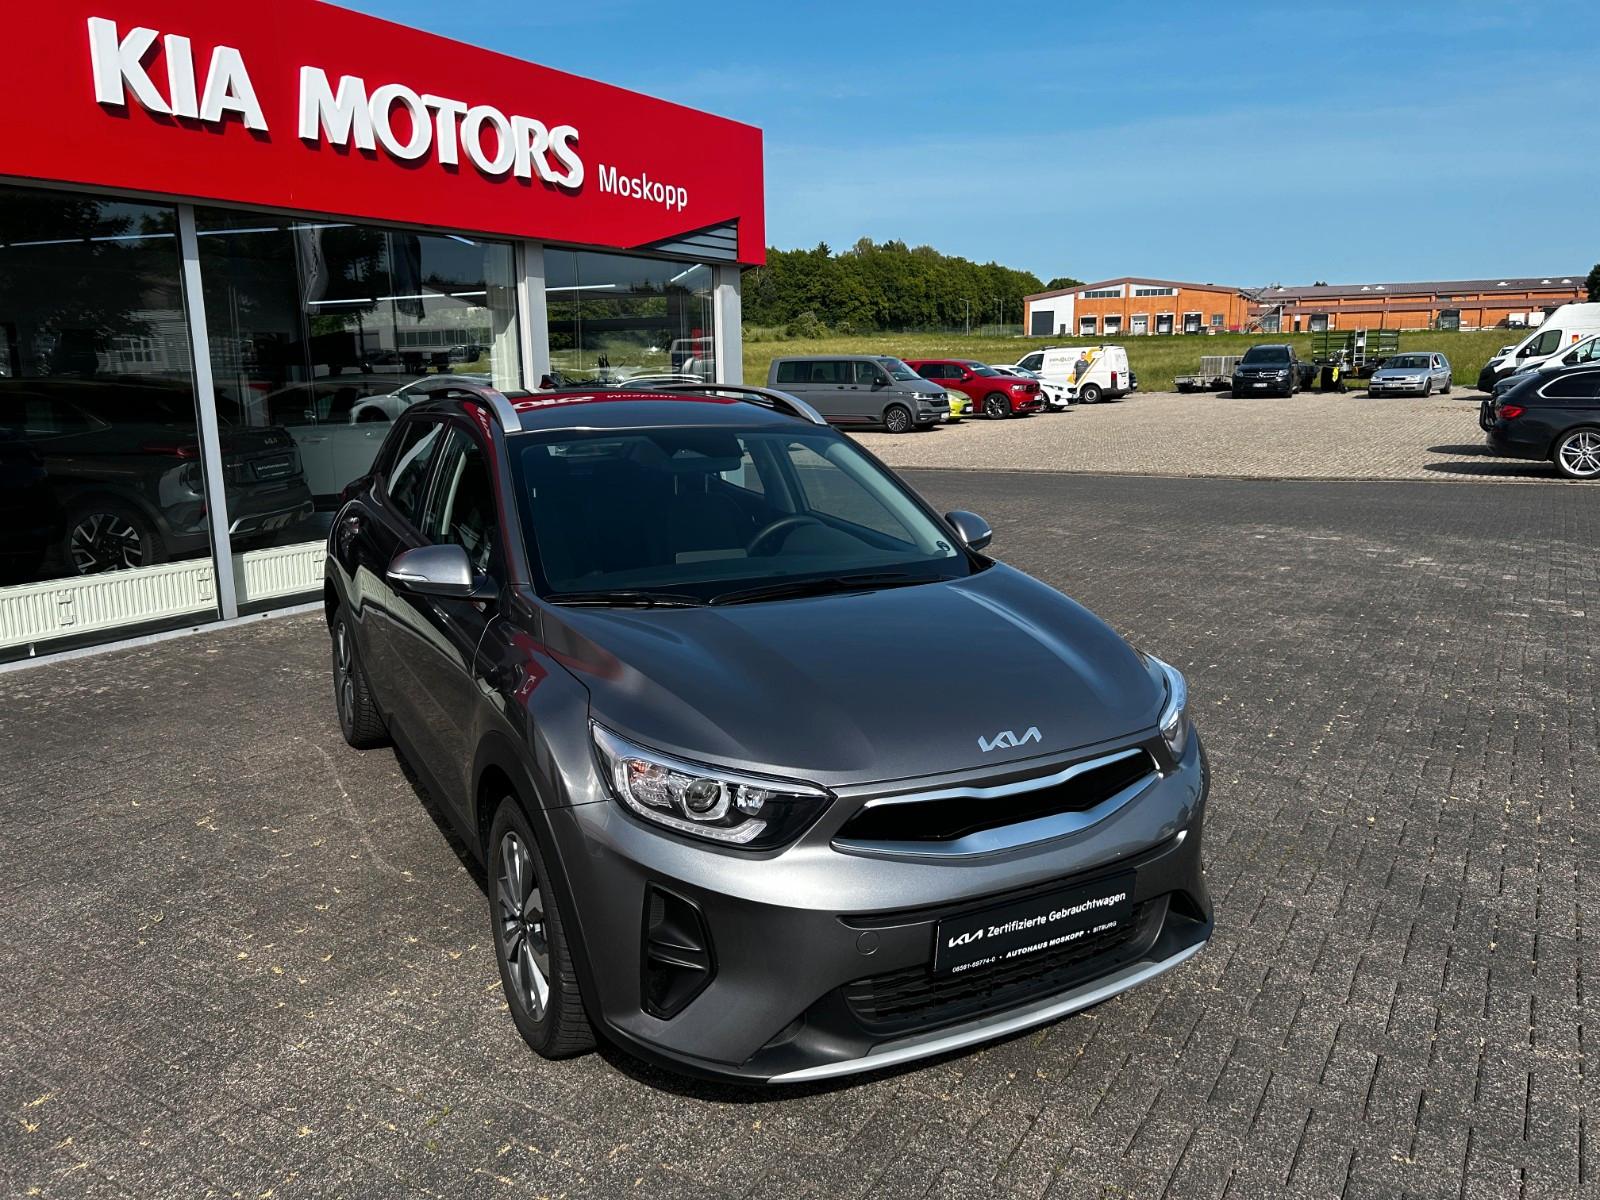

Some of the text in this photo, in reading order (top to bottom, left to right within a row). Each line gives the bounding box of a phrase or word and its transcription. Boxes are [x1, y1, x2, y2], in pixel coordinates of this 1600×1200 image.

[88, 17, 585, 189] KIA MOTORS
[598, 163, 688, 212] Moskopp
[977, 726, 1042, 753] KIA
[987, 915, 1047, 937] Zertifizierte
[1048, 892, 1126, 922] Gebrauchtwagen
[1049, 930, 1085, 946] MOSKOPP
